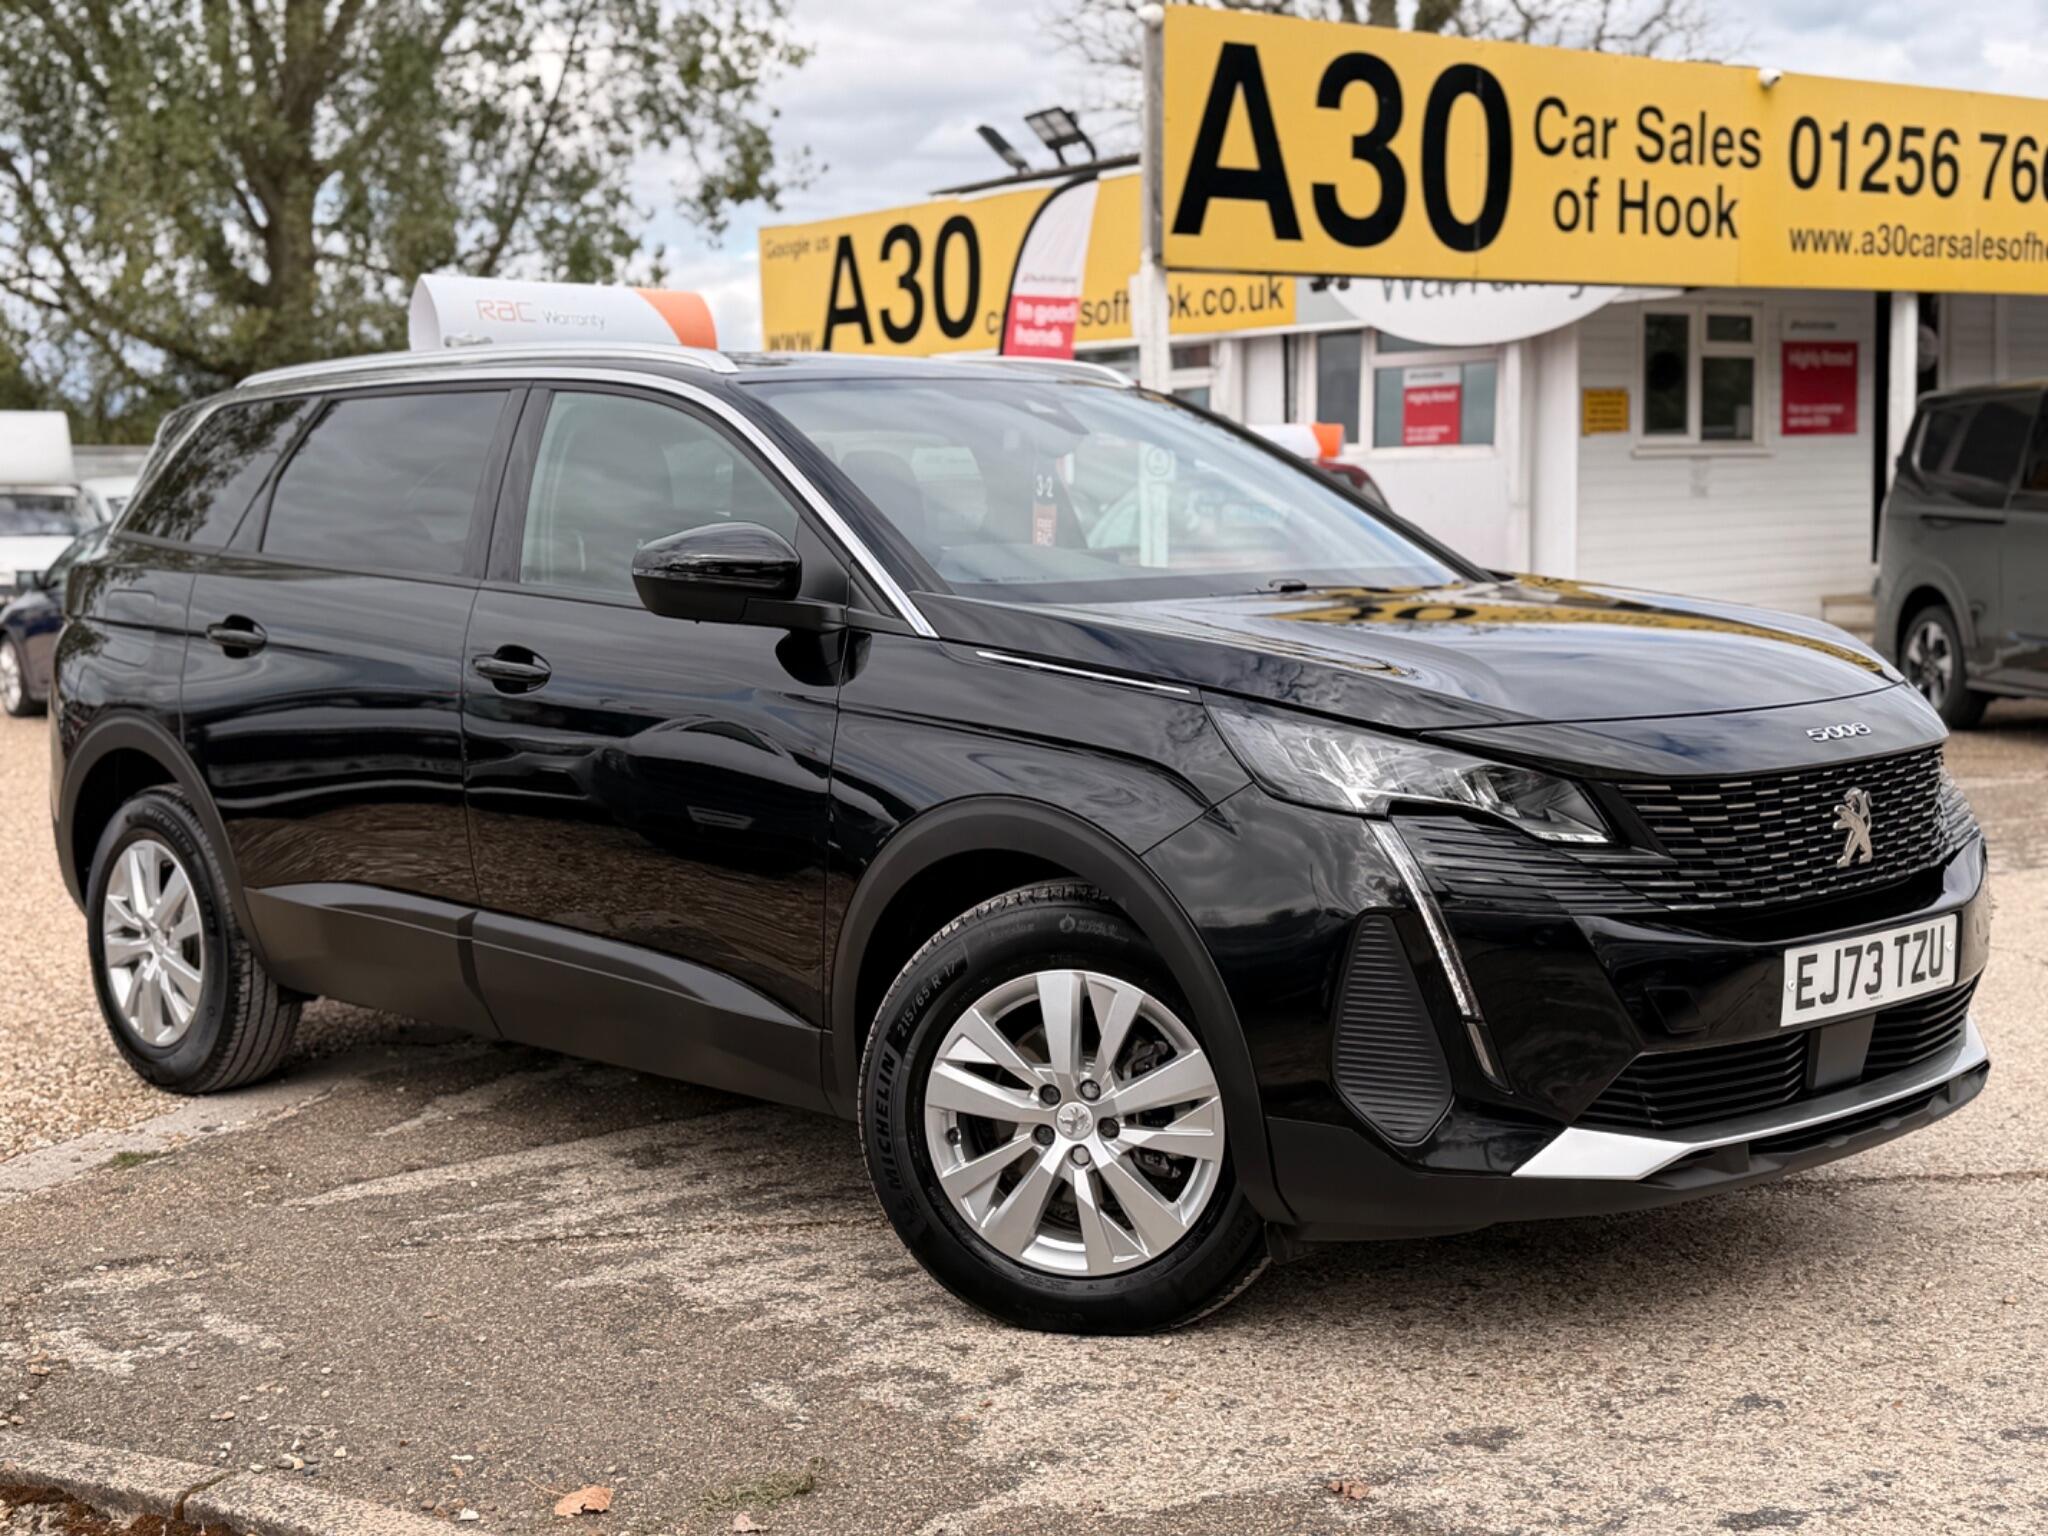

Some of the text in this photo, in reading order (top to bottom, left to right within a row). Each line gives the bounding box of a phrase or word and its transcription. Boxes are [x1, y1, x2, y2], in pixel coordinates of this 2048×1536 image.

[1171, 41, 1514, 253] A30
[1534, 96, 1762, 169] Car Sales
[1789, 115, 2048, 204] 01256 76
[1553, 176, 1739, 239] of Hook
[540, 310, 606, 331] Warranty
[822, 214, 981, 352] A30
[1806, 722, 1872, 742] 5008
[1795, 924, 1945, 1012] EJ73 TZU
[874, 1051, 902, 1193] MICHELIN
